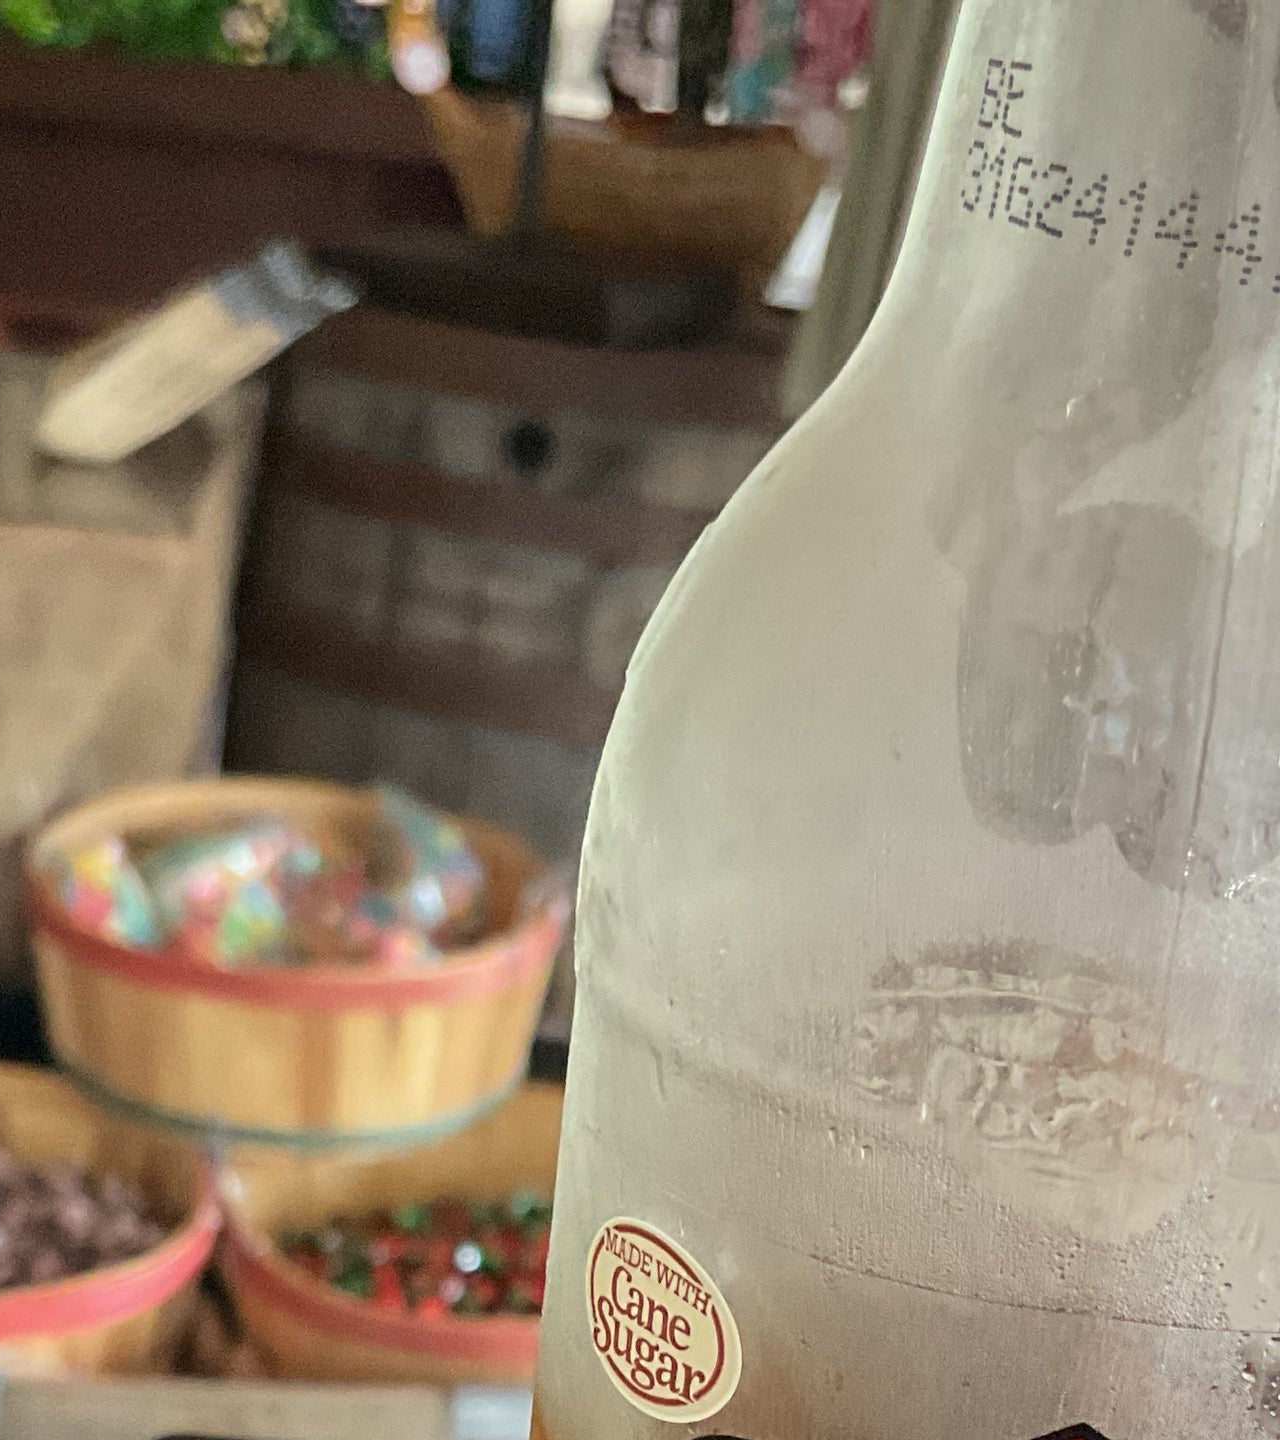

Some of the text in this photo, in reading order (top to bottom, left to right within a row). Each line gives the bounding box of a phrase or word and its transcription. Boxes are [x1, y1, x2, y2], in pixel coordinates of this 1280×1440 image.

[604, 1227, 713, 1317] MADE WITH
[611, 1265, 691, 1351] Cane
[593, 1295, 706, 1403] Sugar
